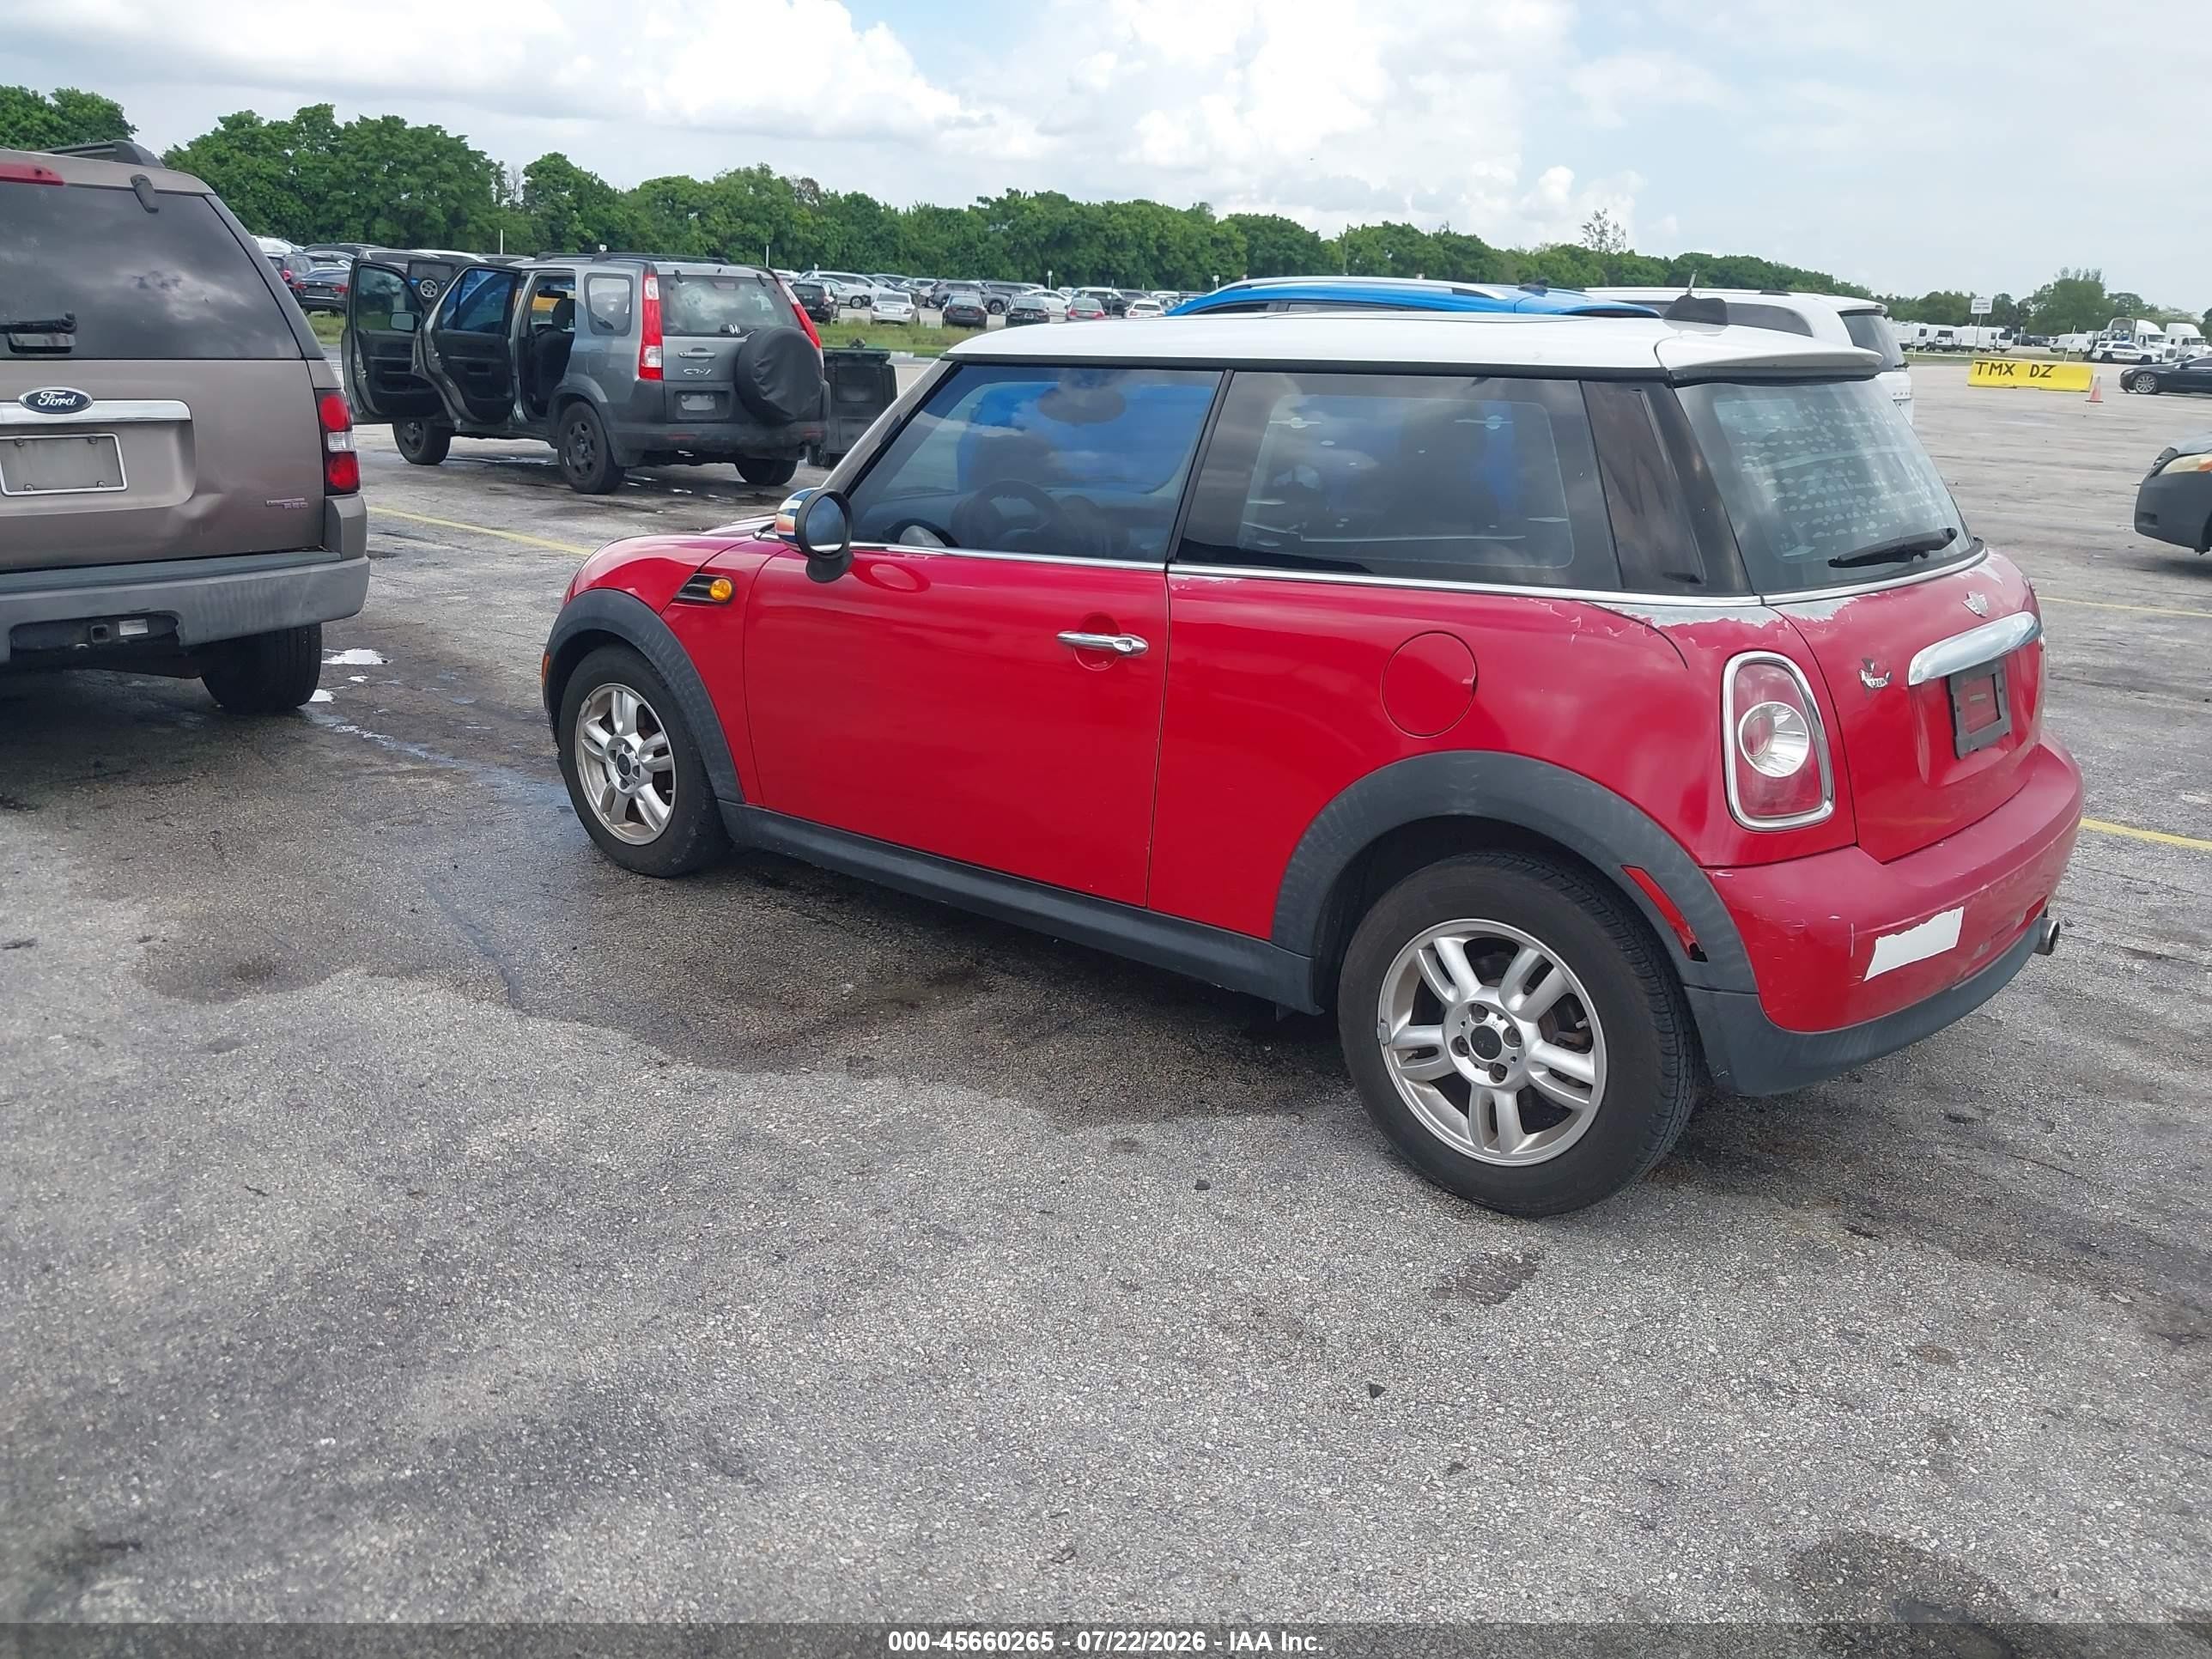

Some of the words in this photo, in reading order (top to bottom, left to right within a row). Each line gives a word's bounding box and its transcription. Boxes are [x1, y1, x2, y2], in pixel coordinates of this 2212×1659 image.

[1975, 362, 2016, 376] TMX
[2029, 364, 2057, 378] DZ
[37, 391, 77, 406] Ford
